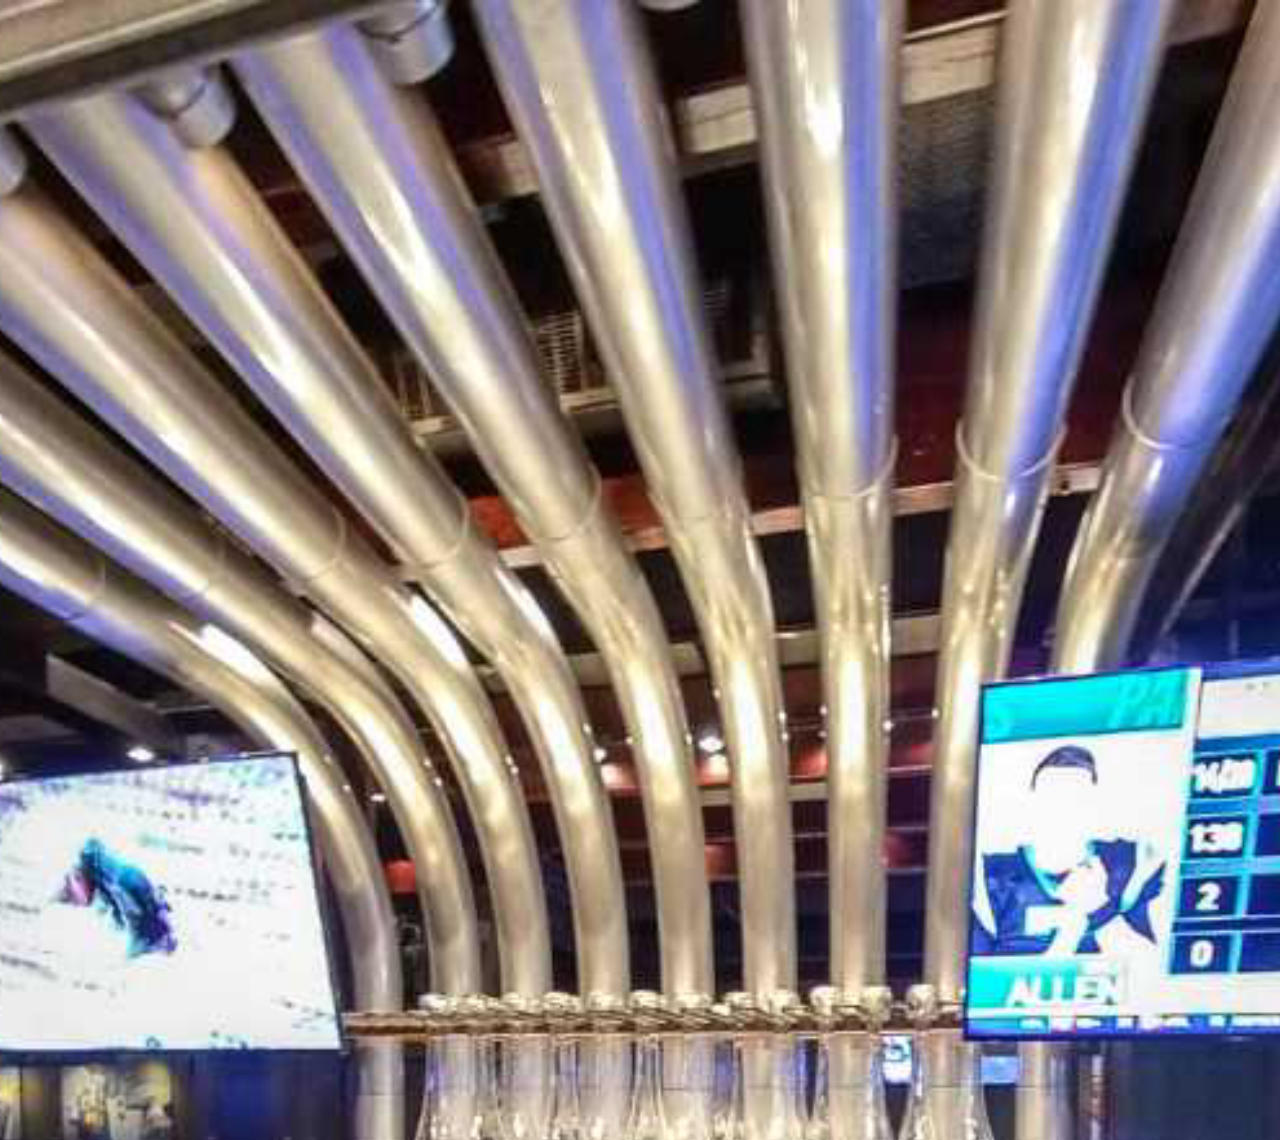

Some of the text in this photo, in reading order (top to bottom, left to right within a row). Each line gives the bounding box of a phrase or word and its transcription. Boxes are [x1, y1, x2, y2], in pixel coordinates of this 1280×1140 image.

[1195, 881, 1221, 910] 2
[1189, 940, 1215, 968] 0
[1006, 973, 1120, 1008] ALLEN
